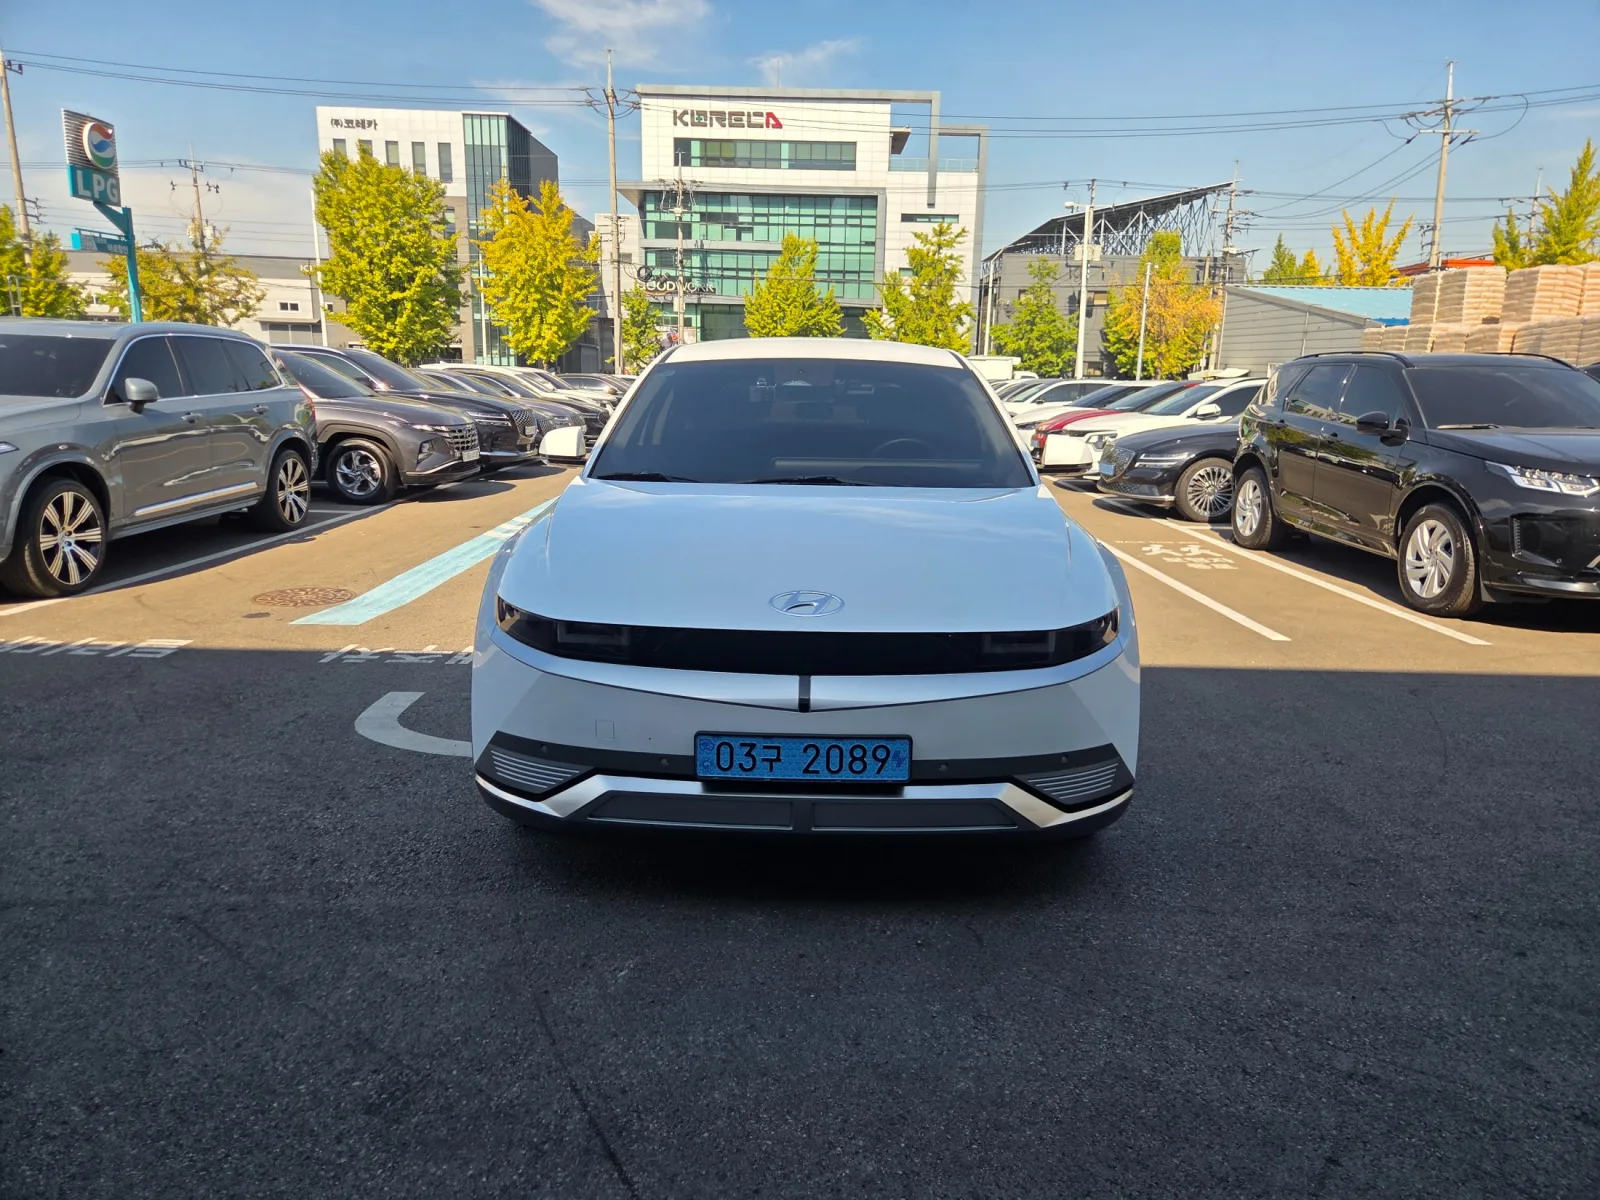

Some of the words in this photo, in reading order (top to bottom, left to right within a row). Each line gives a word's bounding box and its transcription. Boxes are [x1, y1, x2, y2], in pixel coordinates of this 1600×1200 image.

[76, 170, 119, 203] LPG
[715, 741, 782, 773] 03구
[802, 743, 891, 775] 2089
